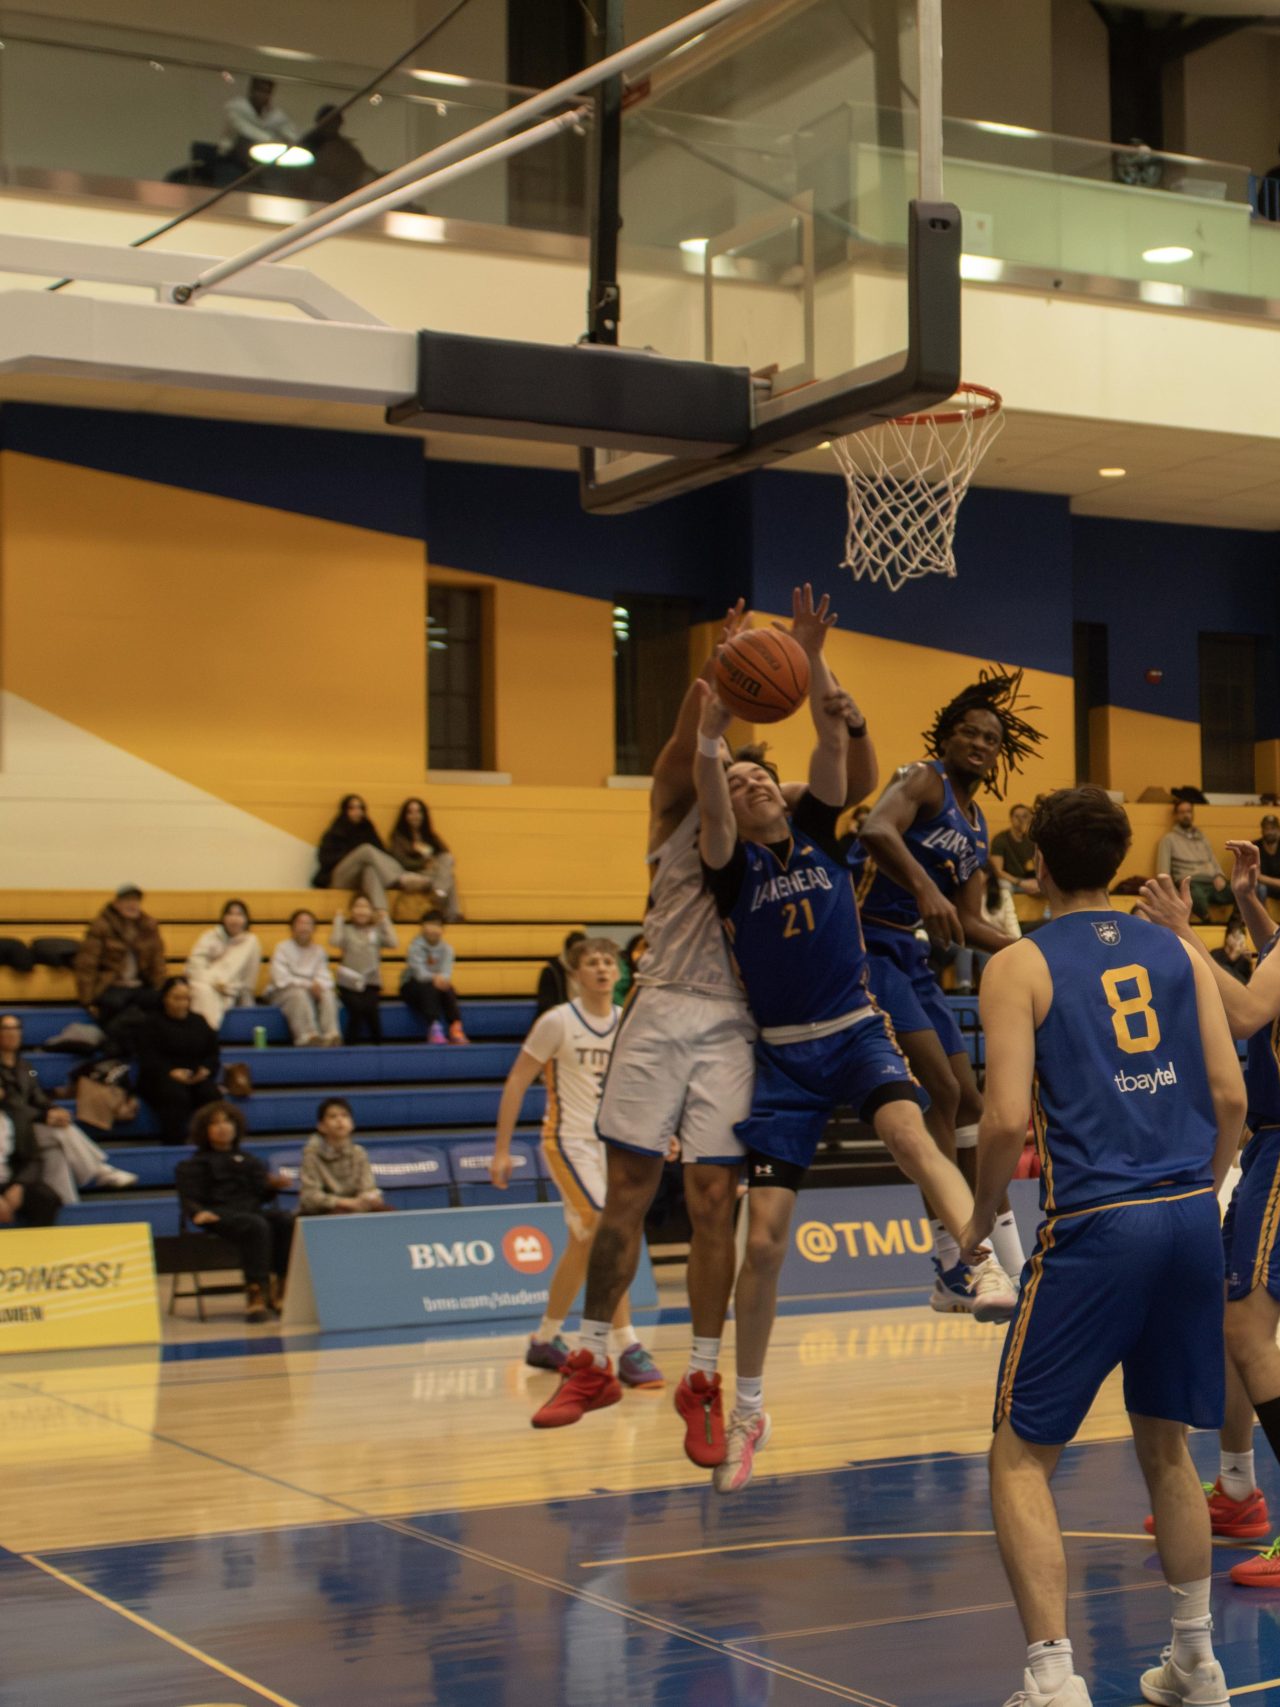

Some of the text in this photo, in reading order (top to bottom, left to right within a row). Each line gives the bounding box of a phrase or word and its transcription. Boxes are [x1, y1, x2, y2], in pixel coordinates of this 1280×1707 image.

[750, 866, 833, 913] LAKEHEAD
[781, 897, 816, 939] 21
[1100, 963, 1161, 1054] 8
[1113, 1061, 1177, 1094] tbaytel
[407, 1239, 495, 1270] BMO
